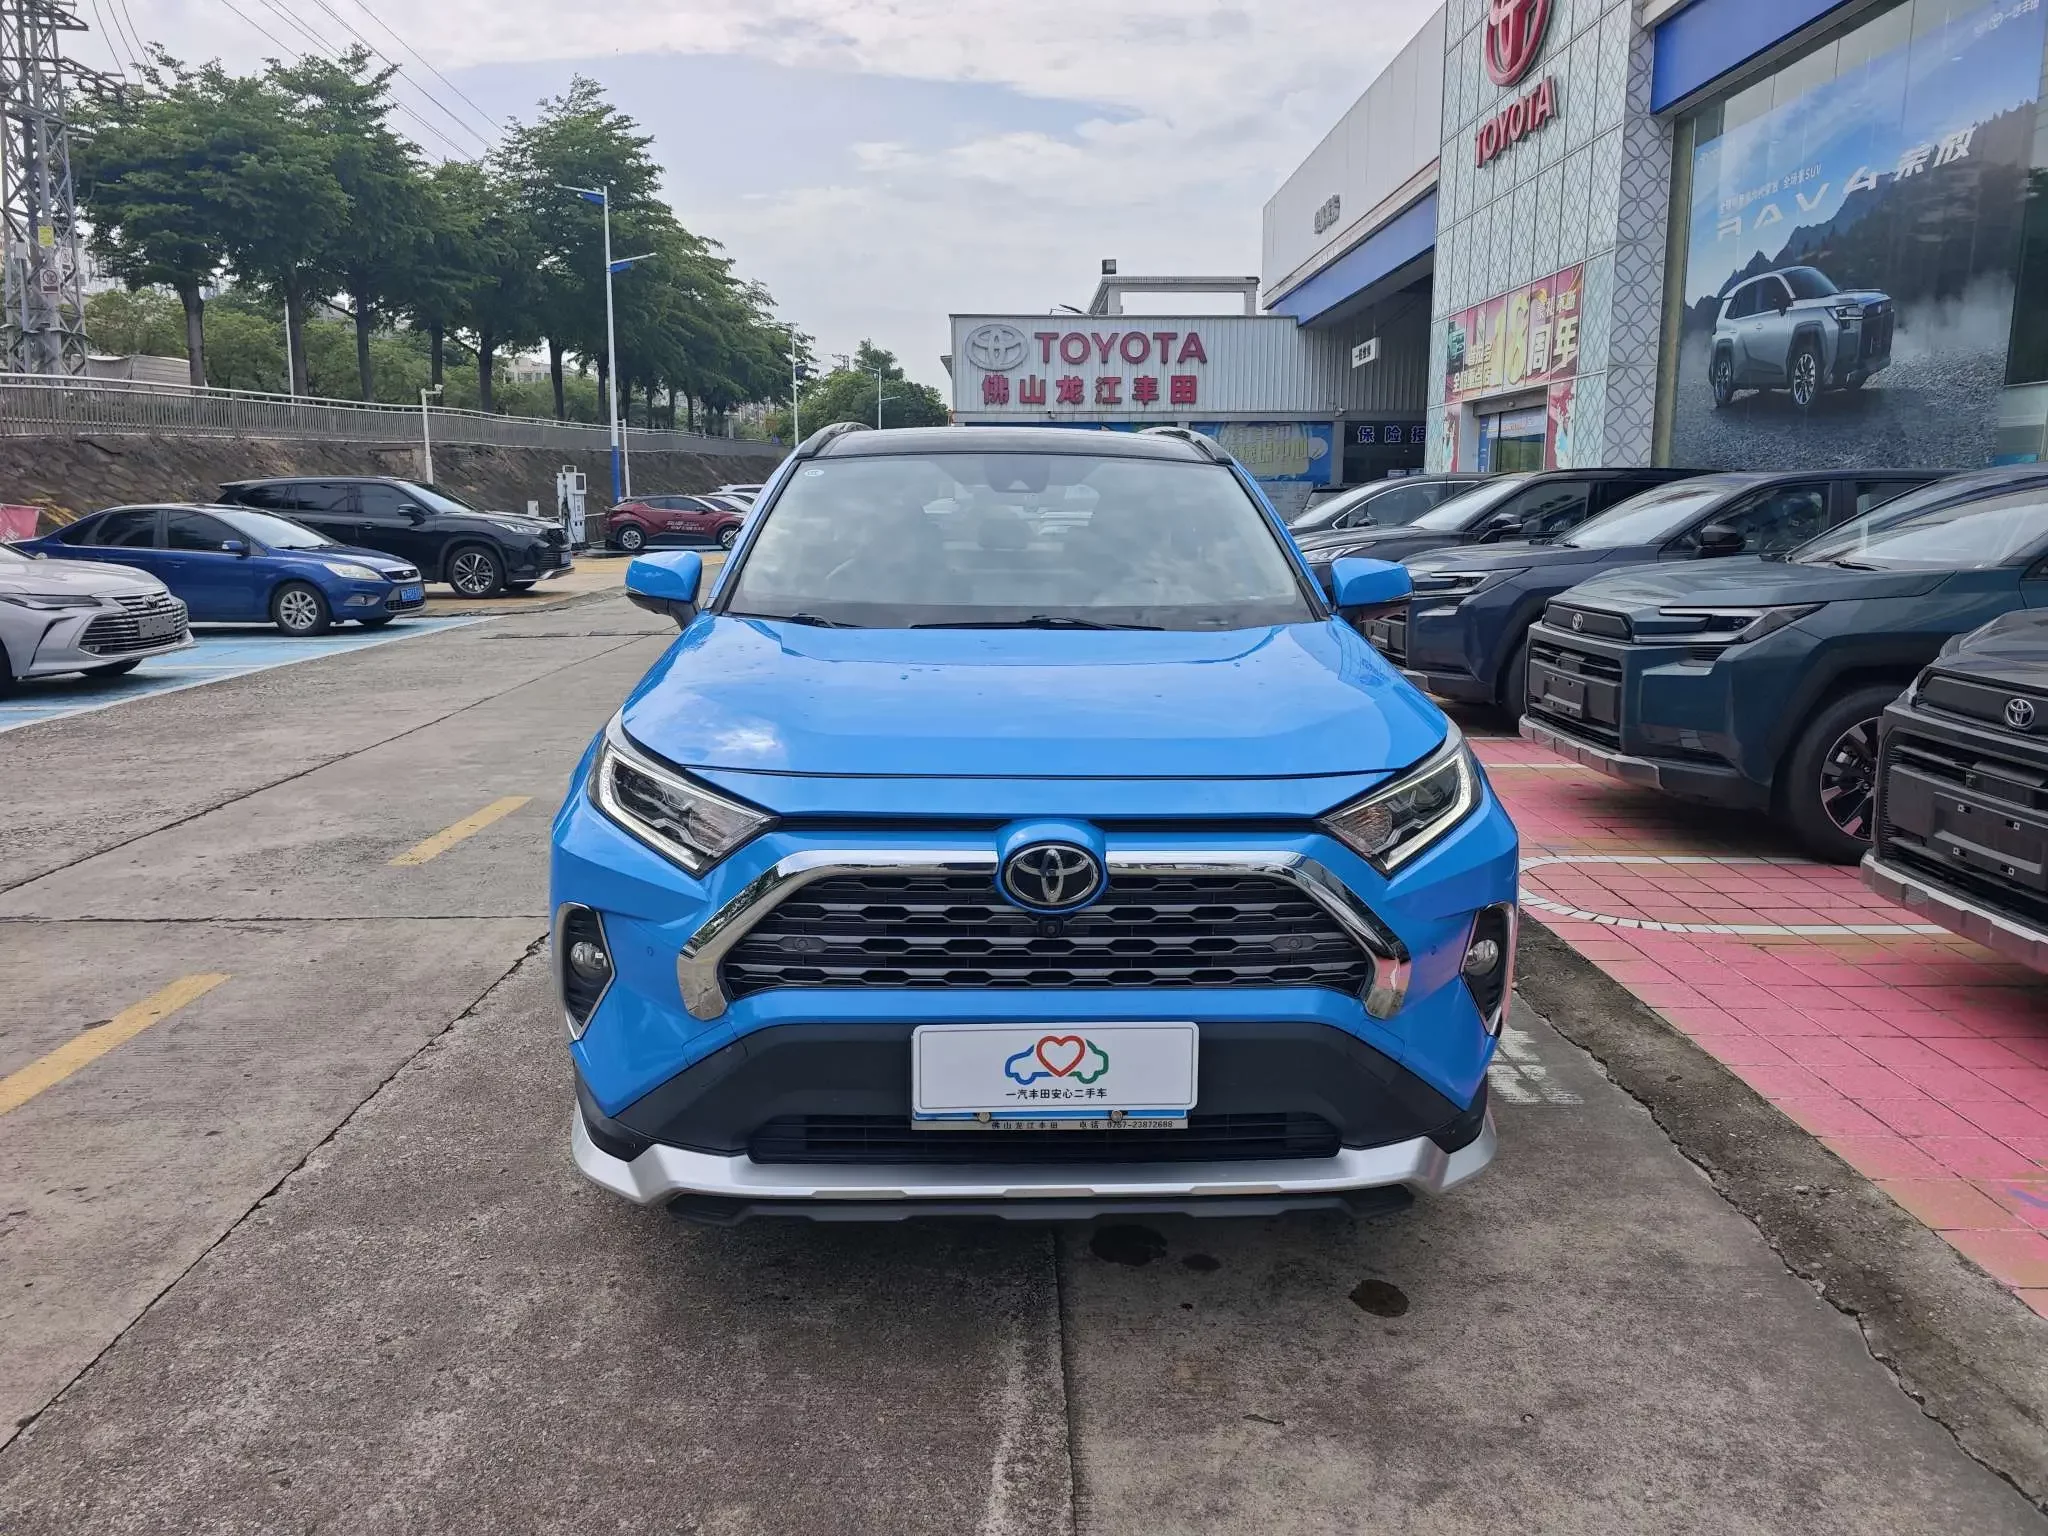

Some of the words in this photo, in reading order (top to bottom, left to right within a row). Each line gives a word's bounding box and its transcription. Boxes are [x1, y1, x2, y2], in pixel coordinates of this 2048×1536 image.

[1475, 75, 1560, 168] TOYOTA
[1034, 331, 1208, 365] TOYOTA
[981, 374, 1198, 405] 佛山龙江丰田
[1005, 1088, 1108, 1099] 一汽丰田安心二手车
